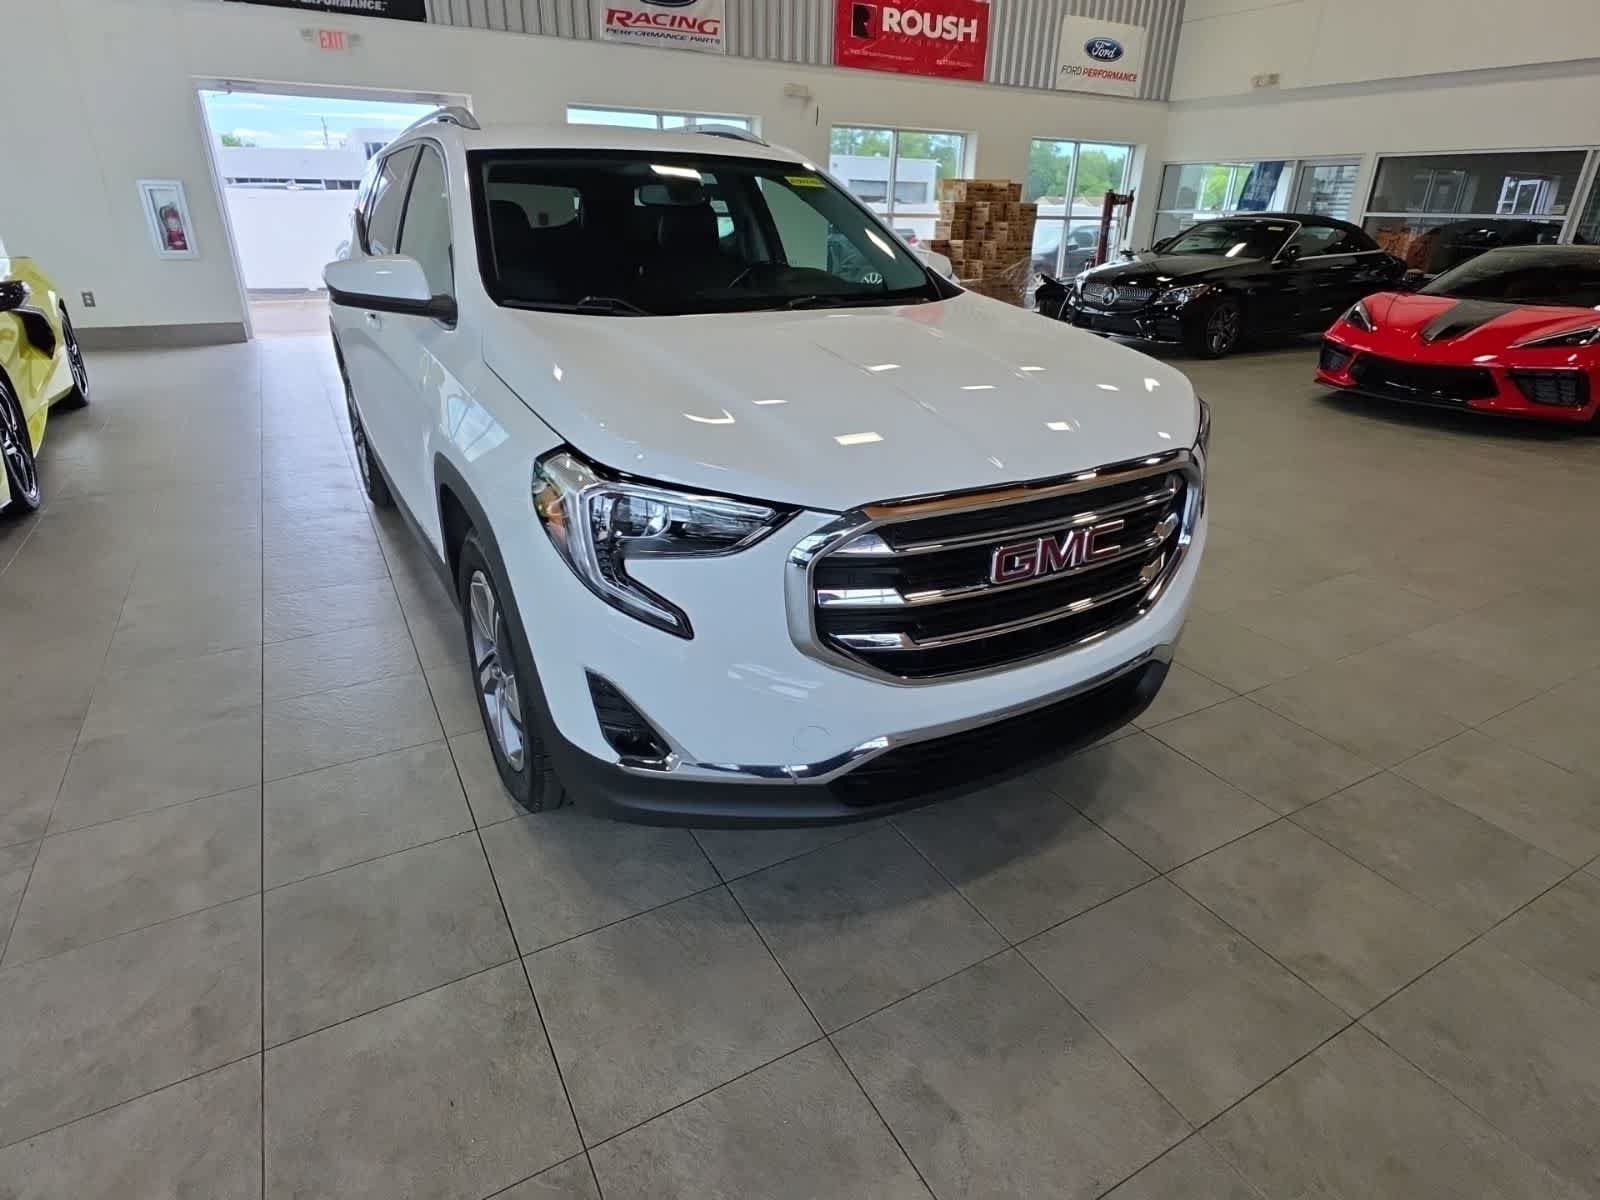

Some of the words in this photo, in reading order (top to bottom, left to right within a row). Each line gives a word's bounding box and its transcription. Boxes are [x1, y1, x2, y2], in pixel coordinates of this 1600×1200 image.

[606, 8, 721, 35] RACING
[882, 7, 978, 43] ROUSH
[319, 30, 345, 49] EXIT
[606, 27, 687, 41] PERFORMANCE
[689, 36, 721, 45] PARTS
[1092, 40, 1117, 58] Ford
[1061, 65, 1082, 76] FORD
[1082, 67, 1137, 82] PERFORMANCE
[990, 519, 1125, 585] GMC
